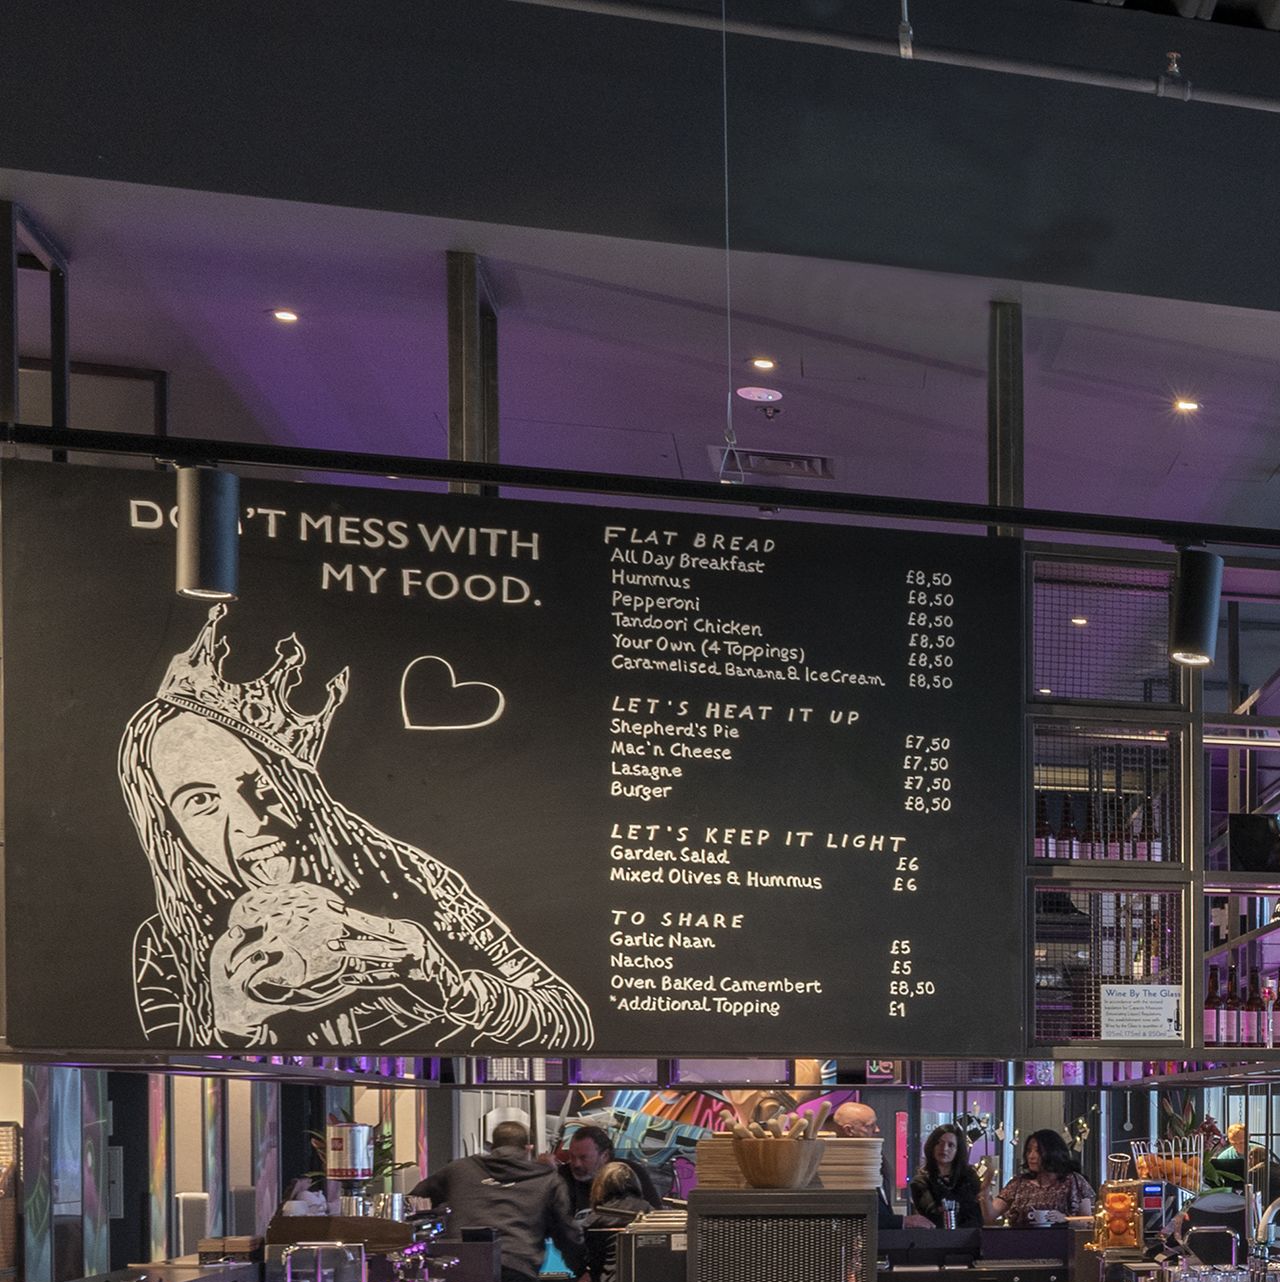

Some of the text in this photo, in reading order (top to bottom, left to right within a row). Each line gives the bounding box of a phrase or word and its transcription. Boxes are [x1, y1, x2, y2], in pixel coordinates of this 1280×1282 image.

[129, 499, 538, 560] D'T MESS WITH
[605, 527, 774, 552] FLAT BREAD
[611, 548, 638, 564] All
[642, 550, 675, 570] Day
[680, 553, 765, 573] Breakfast
[322, 563, 541, 606] MY FOOD.
[612, 569, 690, 589] Hummus
[613, 591, 699, 613] Pepperoni
[611, 612, 688, 631] Tandoori
[694, 618, 763, 636] Chicken
[612, 634, 653, 649] Your
[656, 636, 696, 652] Own
[701, 639, 721, 658] (4
[723, 641, 804, 664] Toppings)
[611, 654, 722, 675] Caramelised
[725, 662, 786, 680] Banana
[787, 666, 800, 680] &
[612, 696, 859, 725] LET'S HEAT IT UP
[609, 718, 707, 739] Shepherd's
[714, 724, 739, 738] Pie
[670, 742, 732, 760] Cheese
[611, 761, 683, 781] Lasagne
[610, 780, 673, 802] Burger
[610, 823, 906, 852] LET'S KEEP IT LIGHT
[610, 844, 919, 871] Garden Salad £6
[609, 866, 917, 891] Mixed Olives & Hummus £6
[611, 909, 744, 928] TO SHARE
[609, 931, 911, 955] Garlic Naan £5
[610, 952, 912, 975] Nachos £5
[611, 974, 657, 990] Oven
[720, 977, 823, 994] Camembert
[1106, 989, 1181, 999] Wine By The Glass
[712, 997, 780, 1017] Topping
[889, 1000, 905, 1017] £1
